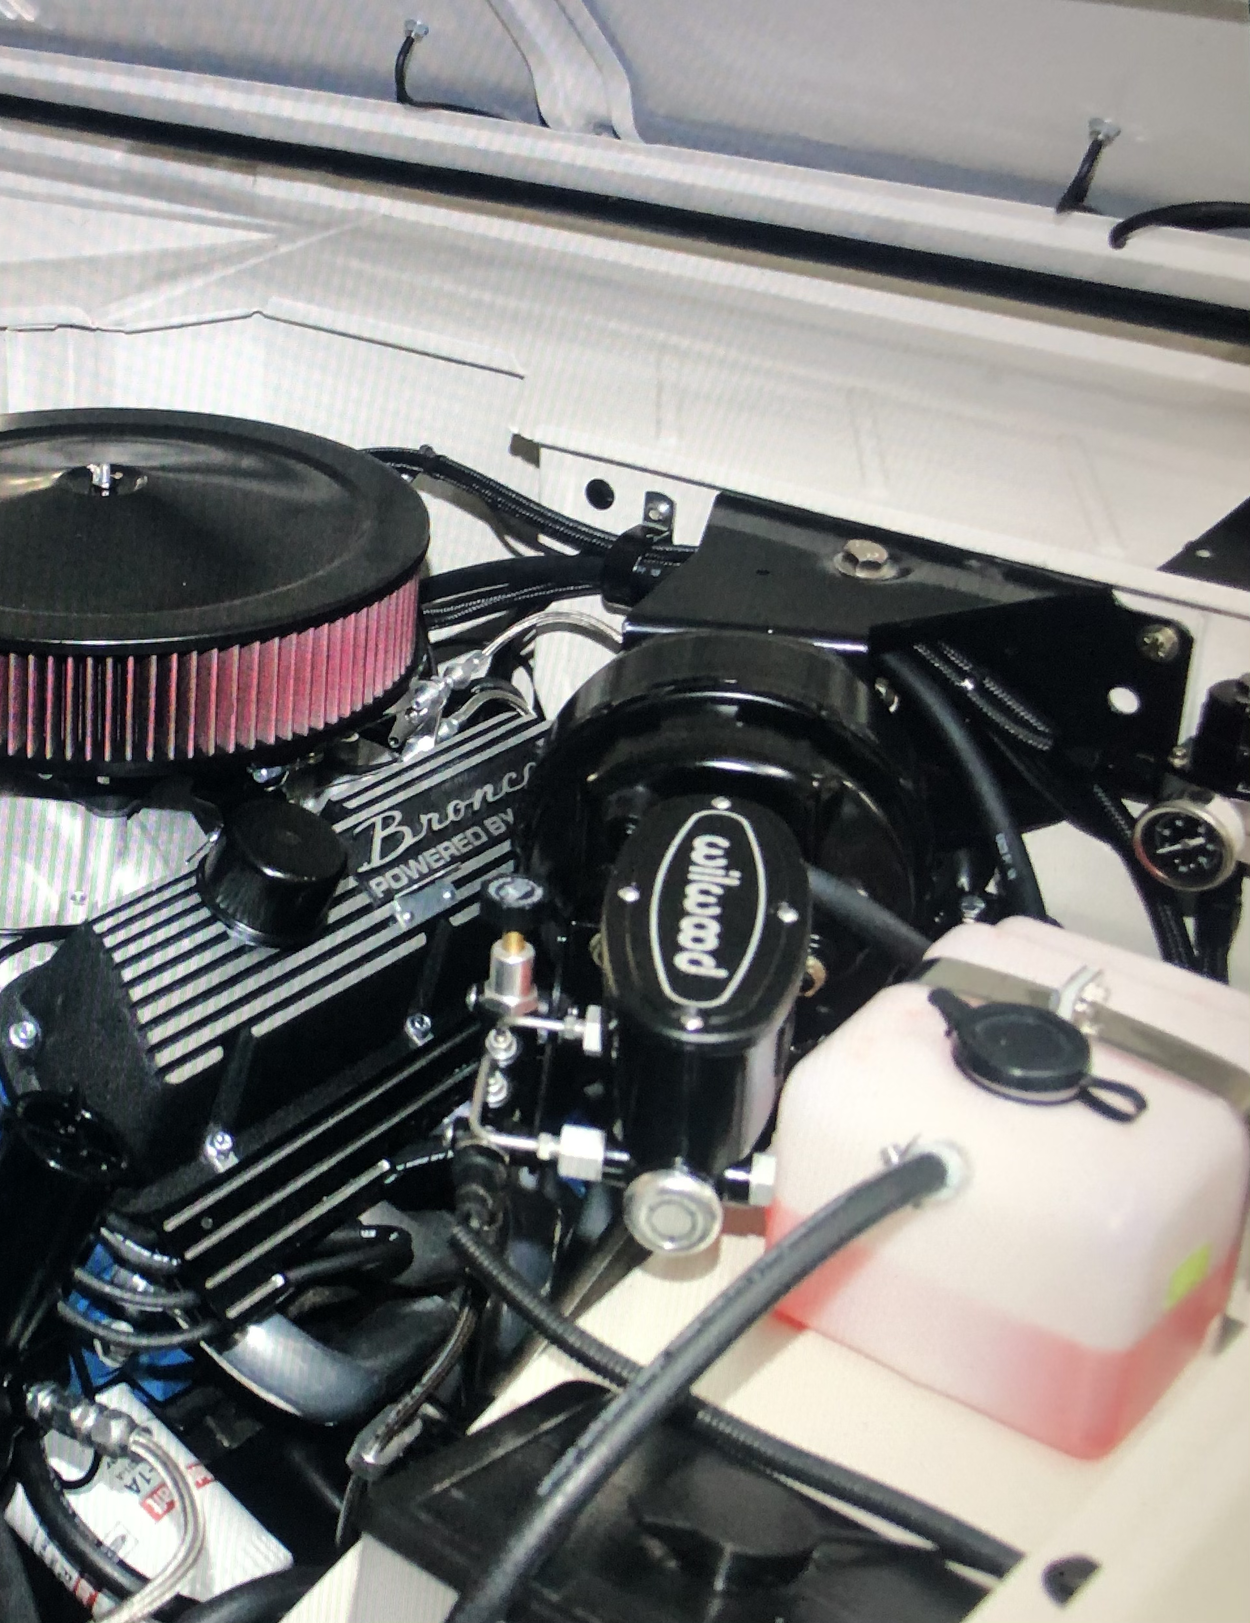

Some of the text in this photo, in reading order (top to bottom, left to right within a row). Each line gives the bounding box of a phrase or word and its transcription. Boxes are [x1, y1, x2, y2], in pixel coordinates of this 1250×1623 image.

[369, 808, 515, 898] POWERED BY
[673, 834, 742, 979] wilwood
